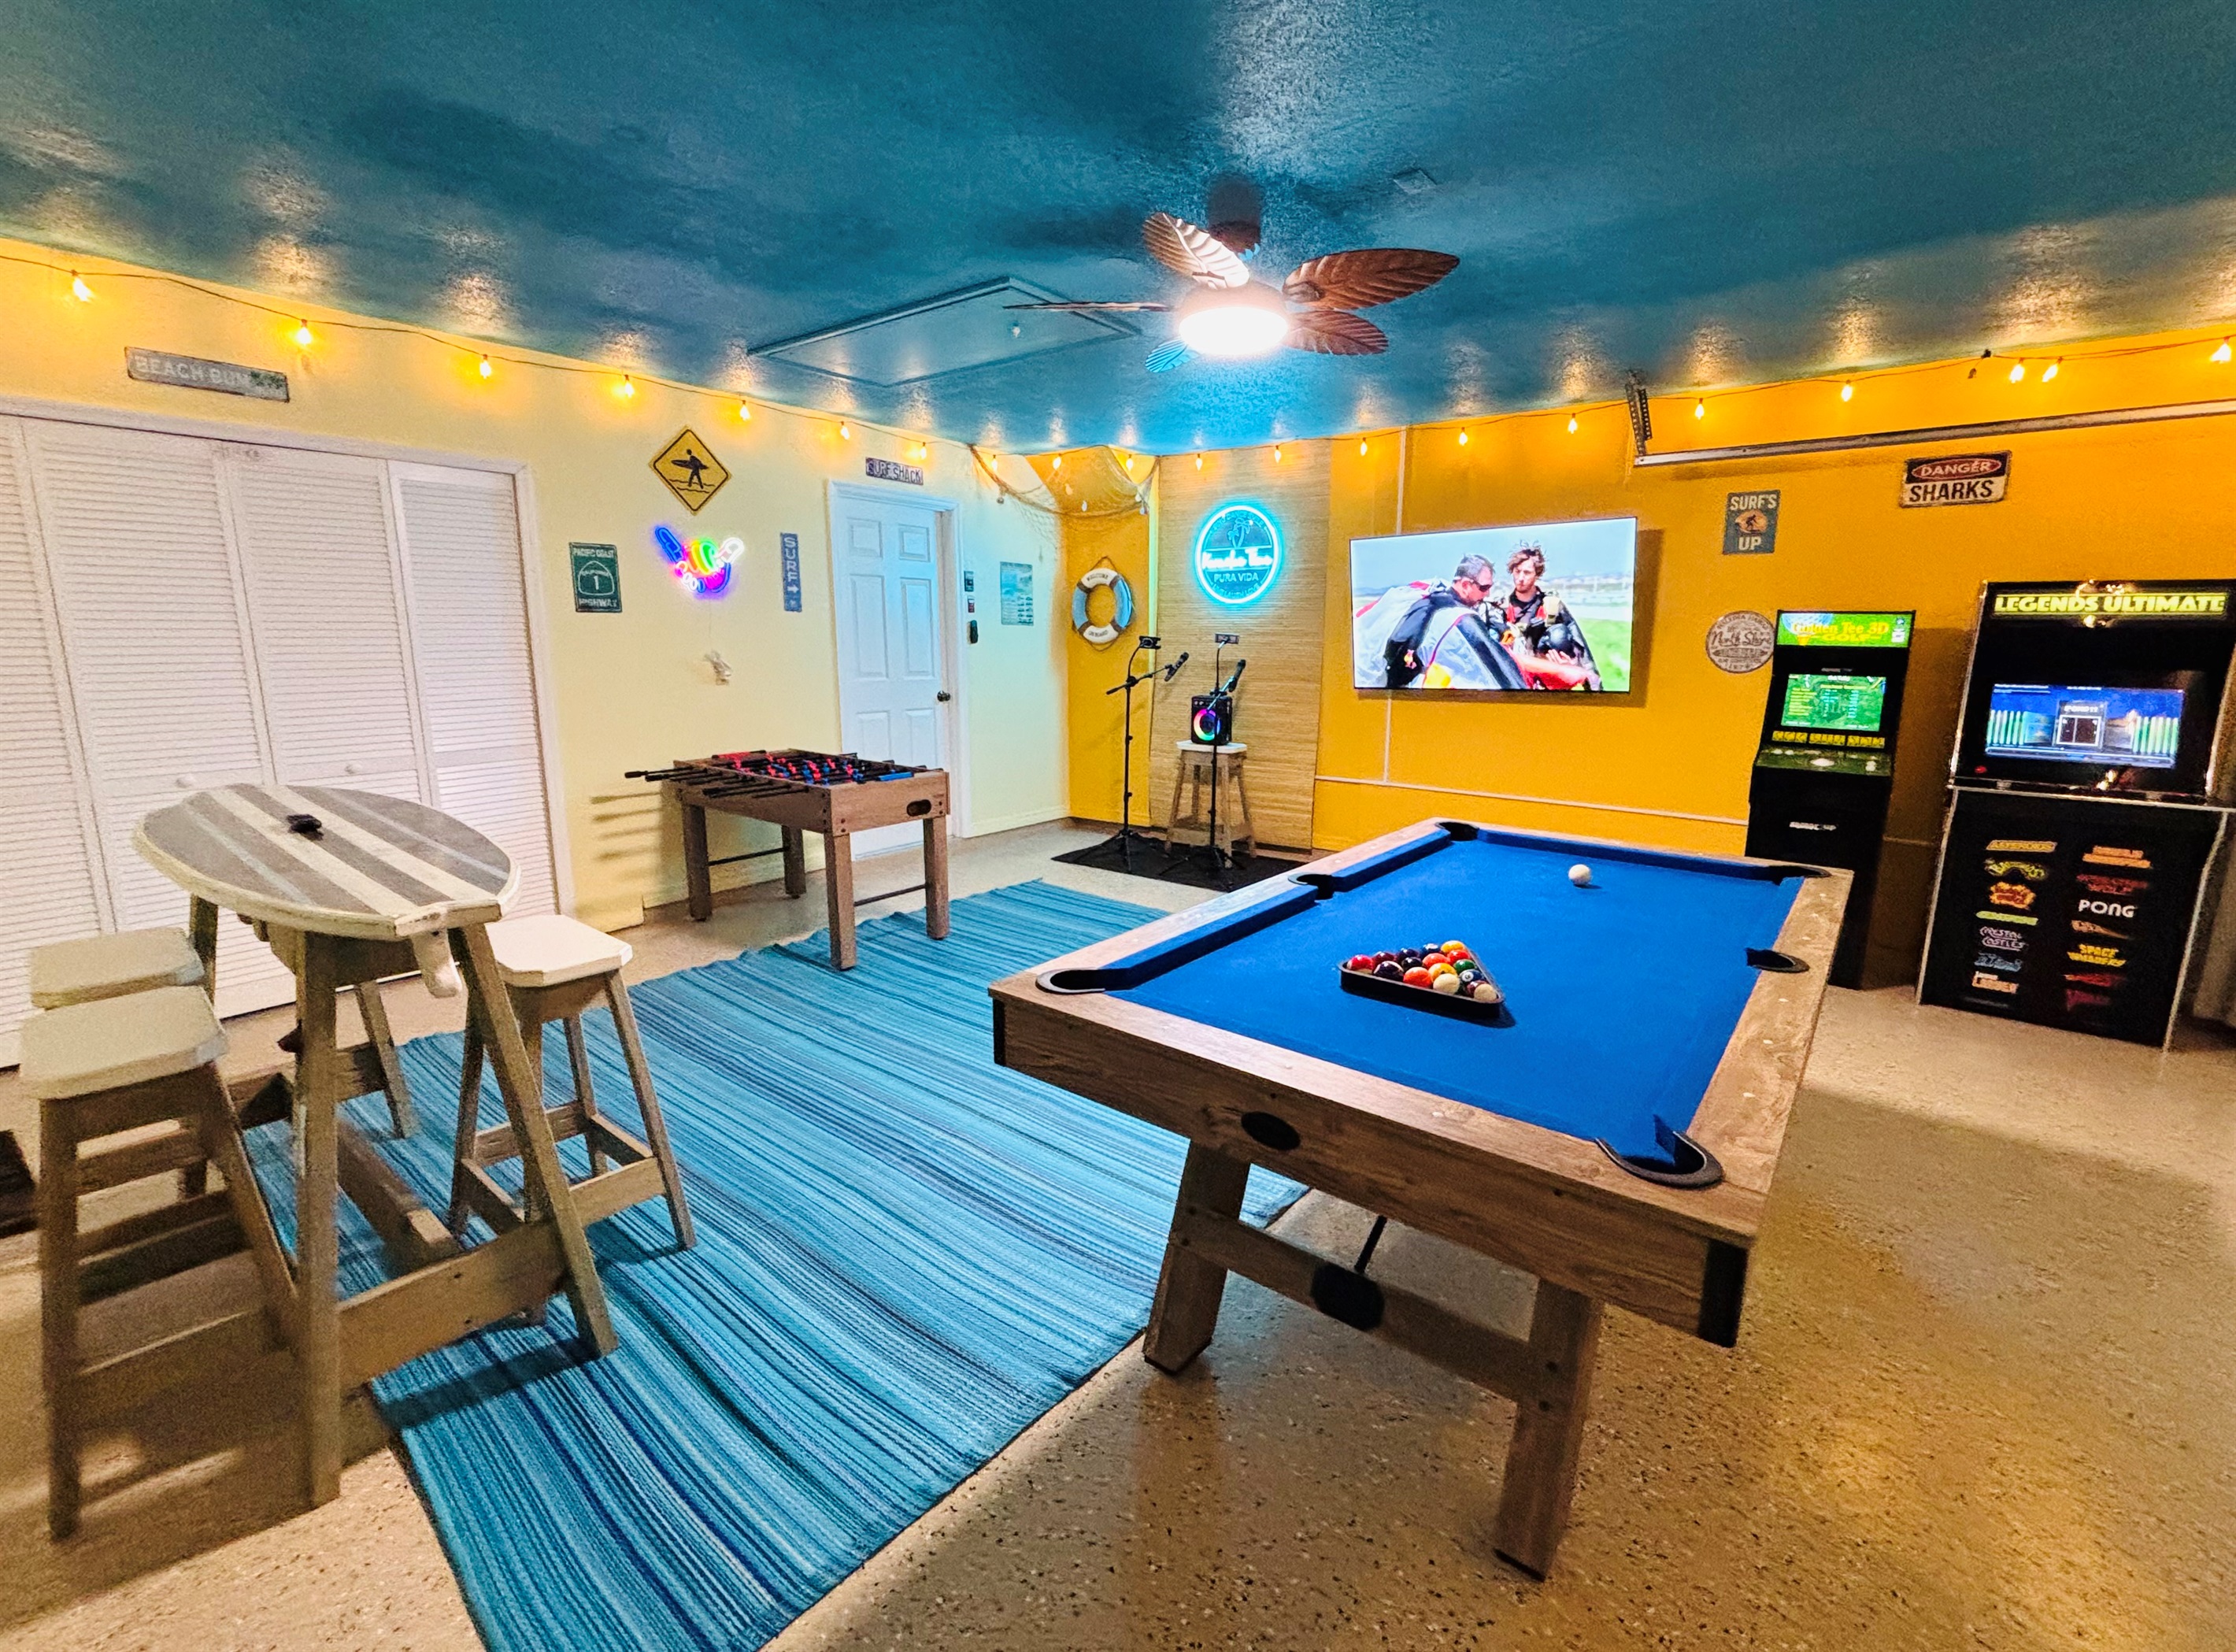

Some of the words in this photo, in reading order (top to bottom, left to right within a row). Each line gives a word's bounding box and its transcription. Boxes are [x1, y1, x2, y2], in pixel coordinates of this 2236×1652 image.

[135, 355, 204, 381] BEACH
[893, 465, 921, 483] SHACK
[1921, 461, 1992, 476] DANGER
[1909, 480, 1994, 502] SHARKS
[1731, 494, 1777, 510] SURF'S
[1738, 536, 1762, 550] UP
[596, 549, 614, 558] COAST
[783, 537, 798, 582] SURF
[594, 576, 598, 590] 1
[1214, 573, 1237, 583] PURA
[1238, 572, 1259, 582] VIDA
[1994, 596, 2098, 612] LEGENDS
[2104, 595, 2226, 612] ULTIMATE
[1842, 622, 1864, 635] Tee
[1868, 622, 1890, 635] 3D
[2079, 899, 2135, 918] PONG
